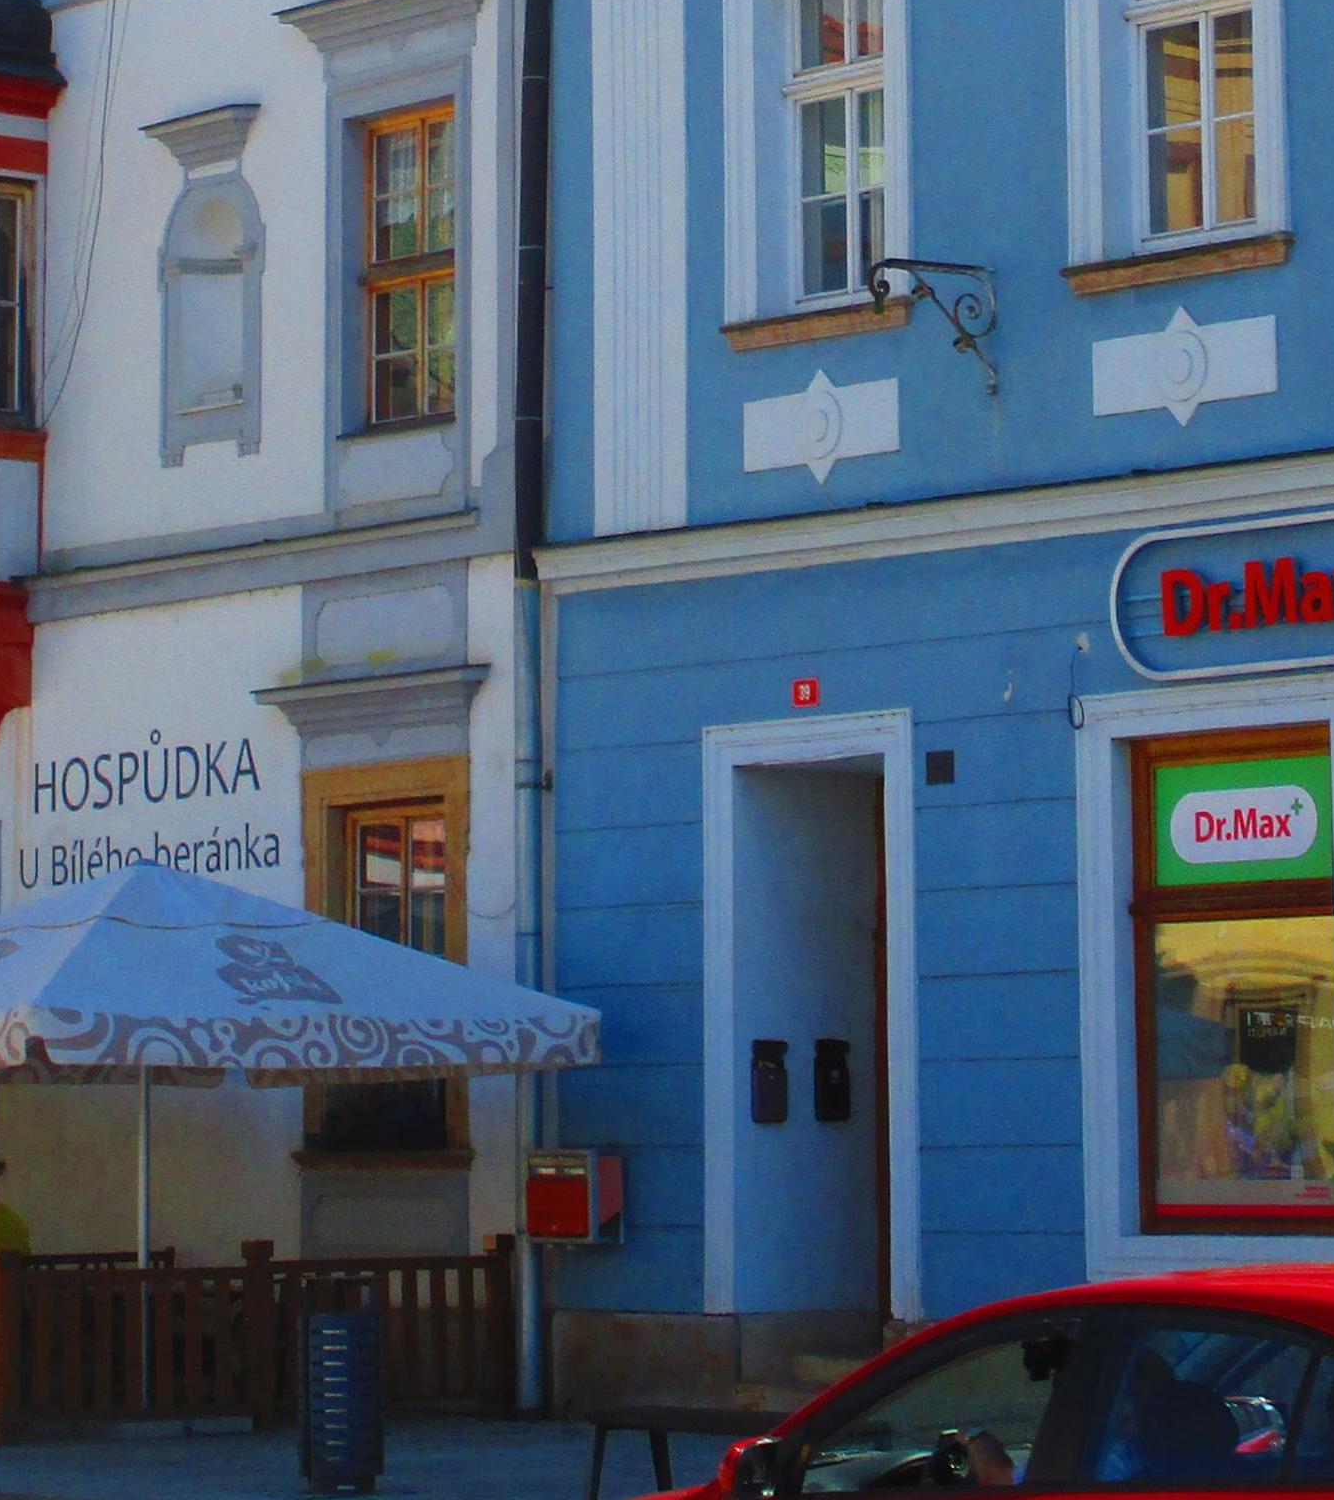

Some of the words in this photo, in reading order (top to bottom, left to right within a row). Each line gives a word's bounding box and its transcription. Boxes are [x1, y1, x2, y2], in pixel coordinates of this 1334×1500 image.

[33, 729, 261, 815] HOSPŮDKA
[19, 847, 40, 889] U
[153, 822, 281, 874] beránka
[1194, 807, 1292, 843] Dr.Max
